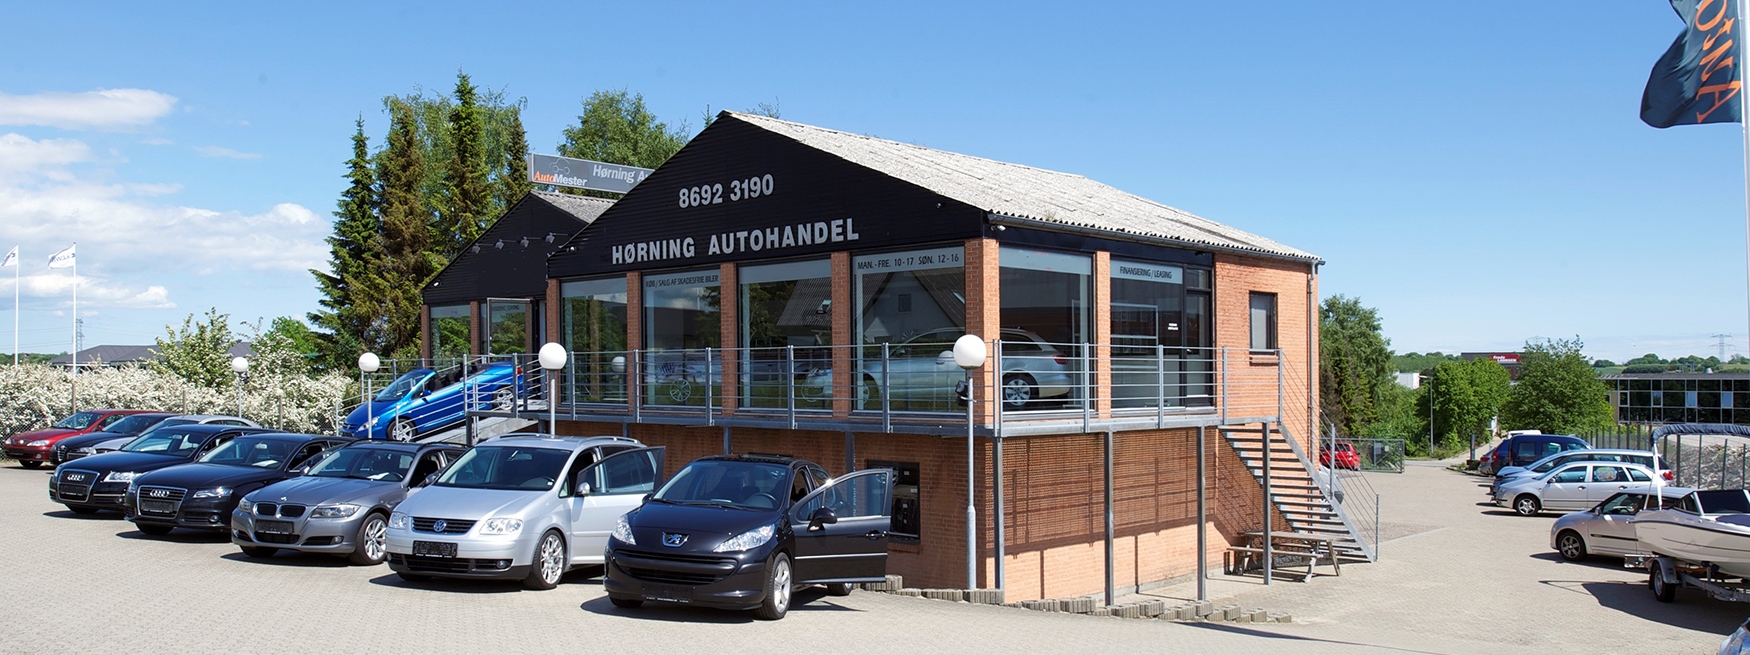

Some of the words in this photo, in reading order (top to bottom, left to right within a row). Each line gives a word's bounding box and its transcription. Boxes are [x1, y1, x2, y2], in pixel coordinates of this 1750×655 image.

[534, 171, 587, 187] AutoMester
[593, 164, 635, 184] Hørning
[679, 183, 723, 208] 8692
[730, 174, 774, 201] 3190
[612, 237, 695, 265] HØRNING
[708, 218, 859, 255] AUTOHANDEL
[918, 255, 934, 265] SØN.
[658, 279, 670, 287] SALG
[671, 278, 677, 286] AF
[678, 275, 705, 285] SKADESFRIE
[705, 274, 719, 283] BILER
[1120, 266, 1151, 277] FINANSIERING
[1154, 270, 1172, 279] LEASING
